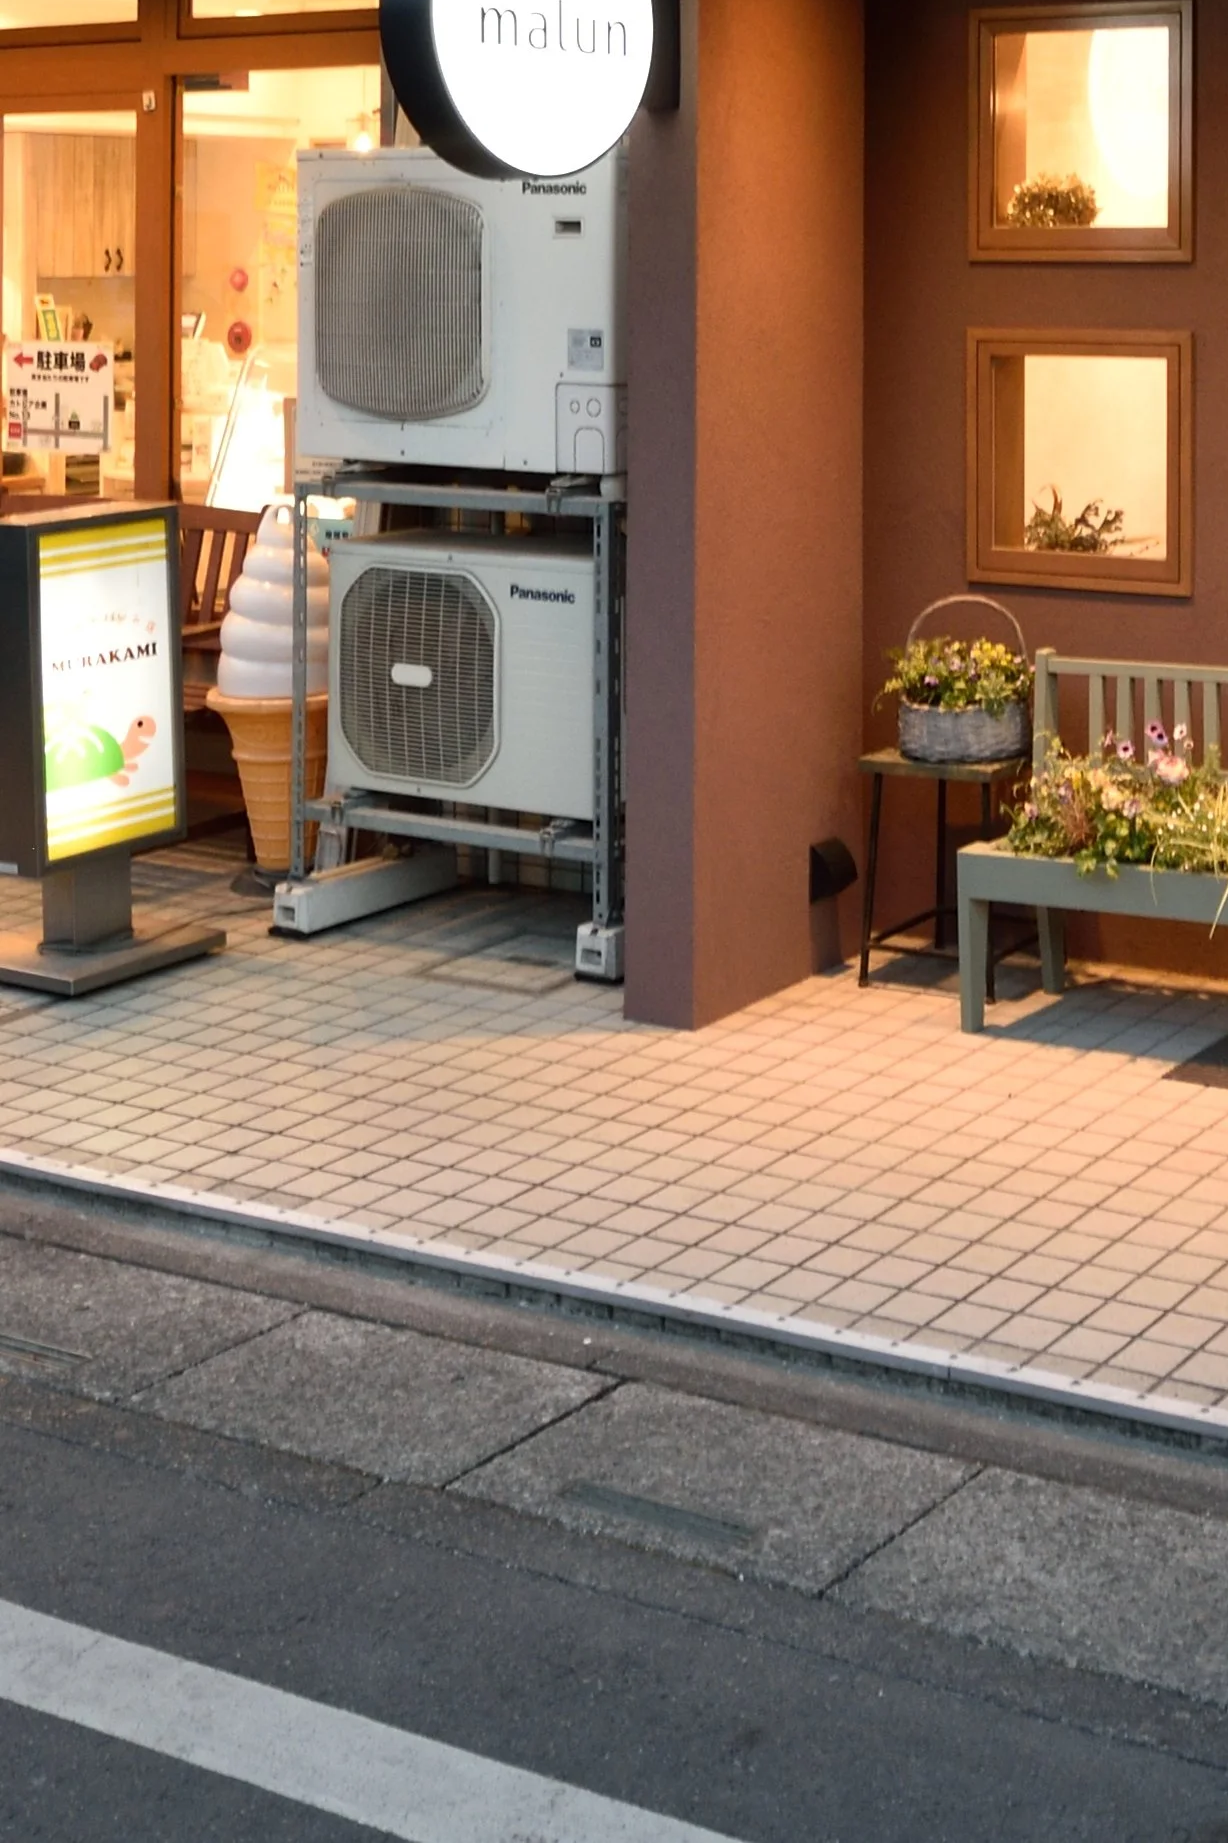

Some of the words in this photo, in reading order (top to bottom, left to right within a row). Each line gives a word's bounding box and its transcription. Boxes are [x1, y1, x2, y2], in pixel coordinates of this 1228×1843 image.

[480, 0, 627, 57] malun
[521, 180, 587, 195] Panasonic
[36, 350, 86, 372] 駐車場
[509, 583, 576, 605] Panasonic
